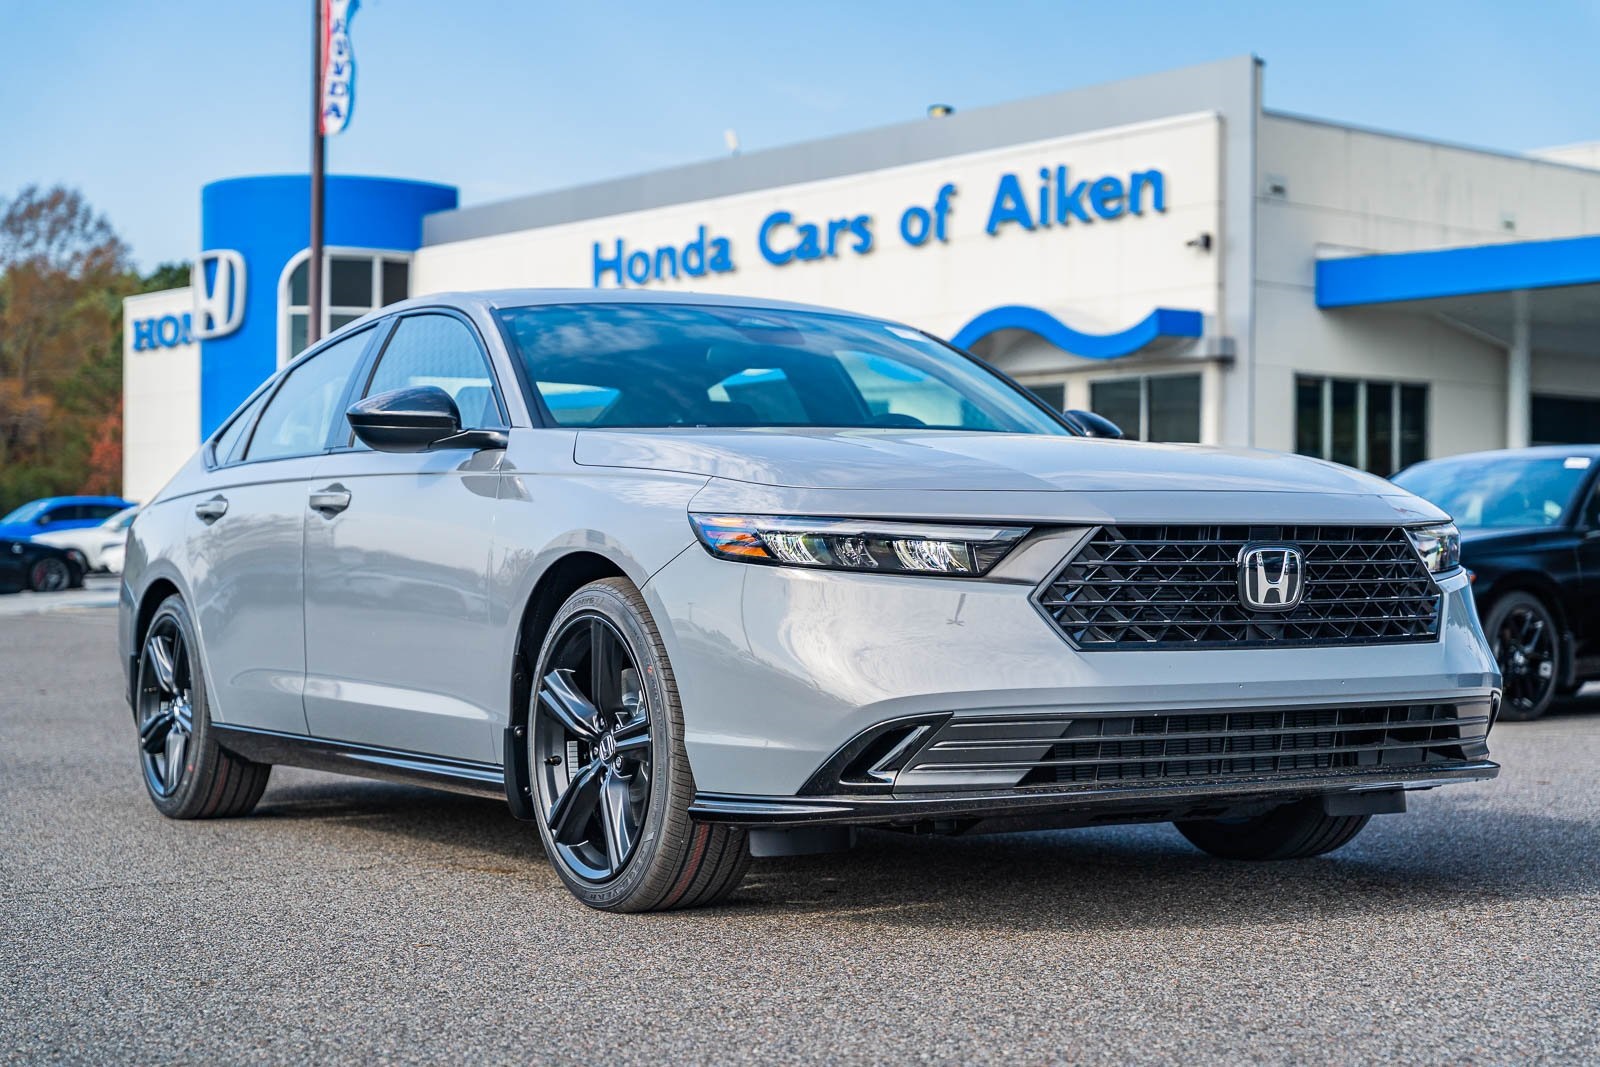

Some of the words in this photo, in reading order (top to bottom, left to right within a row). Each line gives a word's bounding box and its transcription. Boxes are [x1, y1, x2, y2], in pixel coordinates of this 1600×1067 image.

[593, 225, 734, 289] Honda
[758, 211, 874, 265] Cars
[899, 183, 957, 247] of
[985, 164, 1165, 235] Aiken
